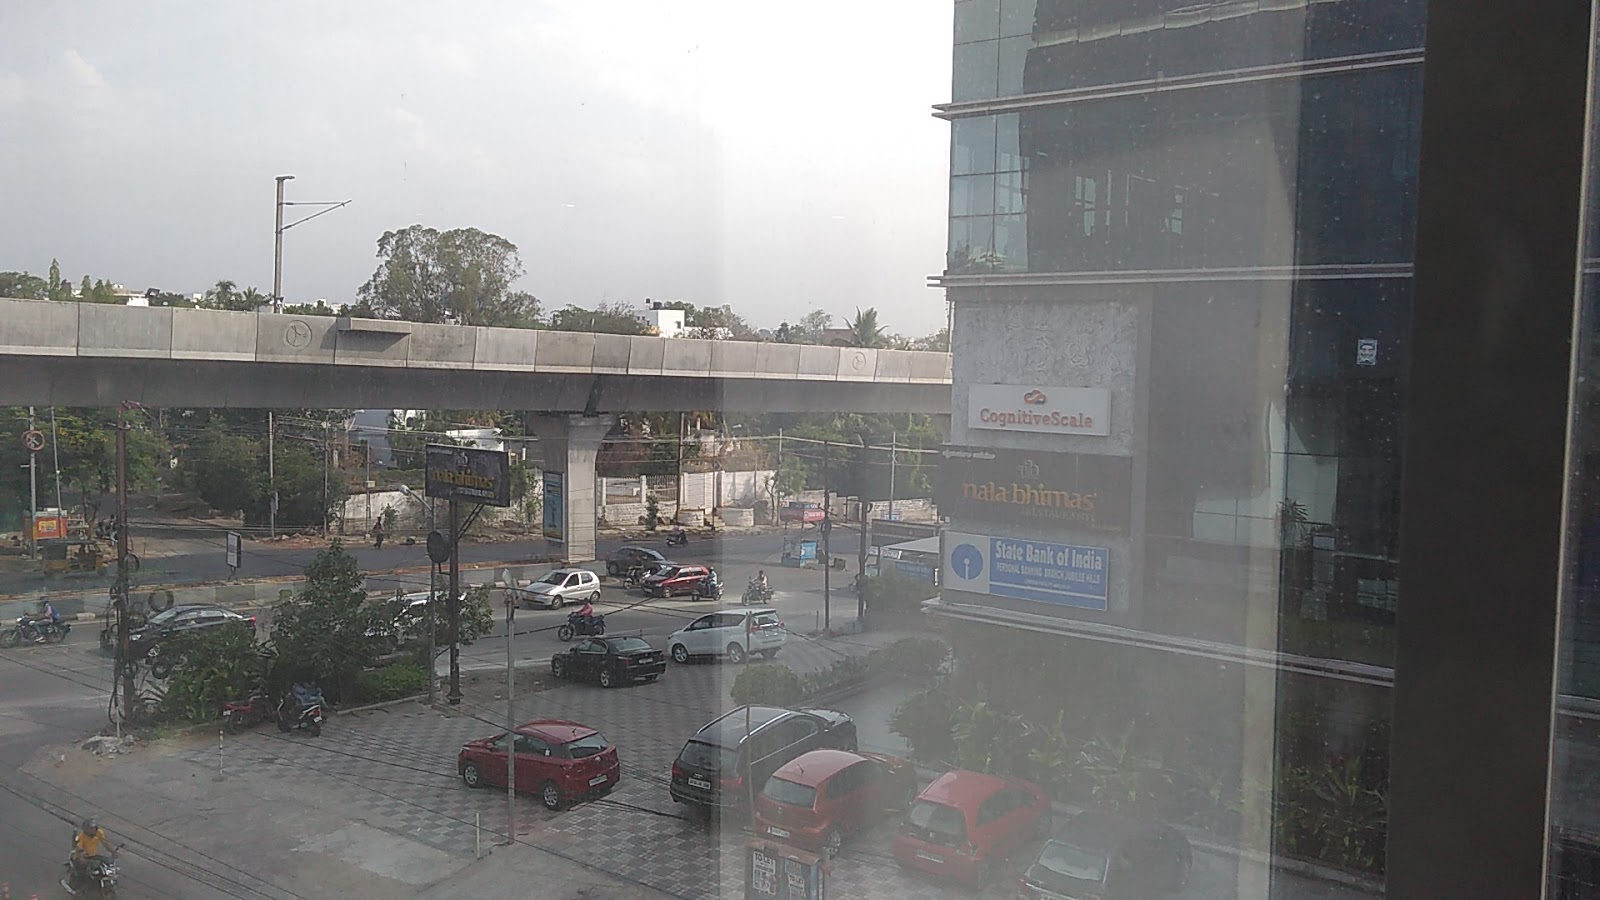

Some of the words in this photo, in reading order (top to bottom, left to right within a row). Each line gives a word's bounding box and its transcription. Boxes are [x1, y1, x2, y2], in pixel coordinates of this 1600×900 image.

[980, 408, 1093, 428] CognitiveScale
[995, 541, 1023, 561] State
[1026, 544, 1054, 565] Bank
[1056, 548, 1069, 567] of
[1072, 550, 1102, 570] India
[755, 852, 763, 861] TO
